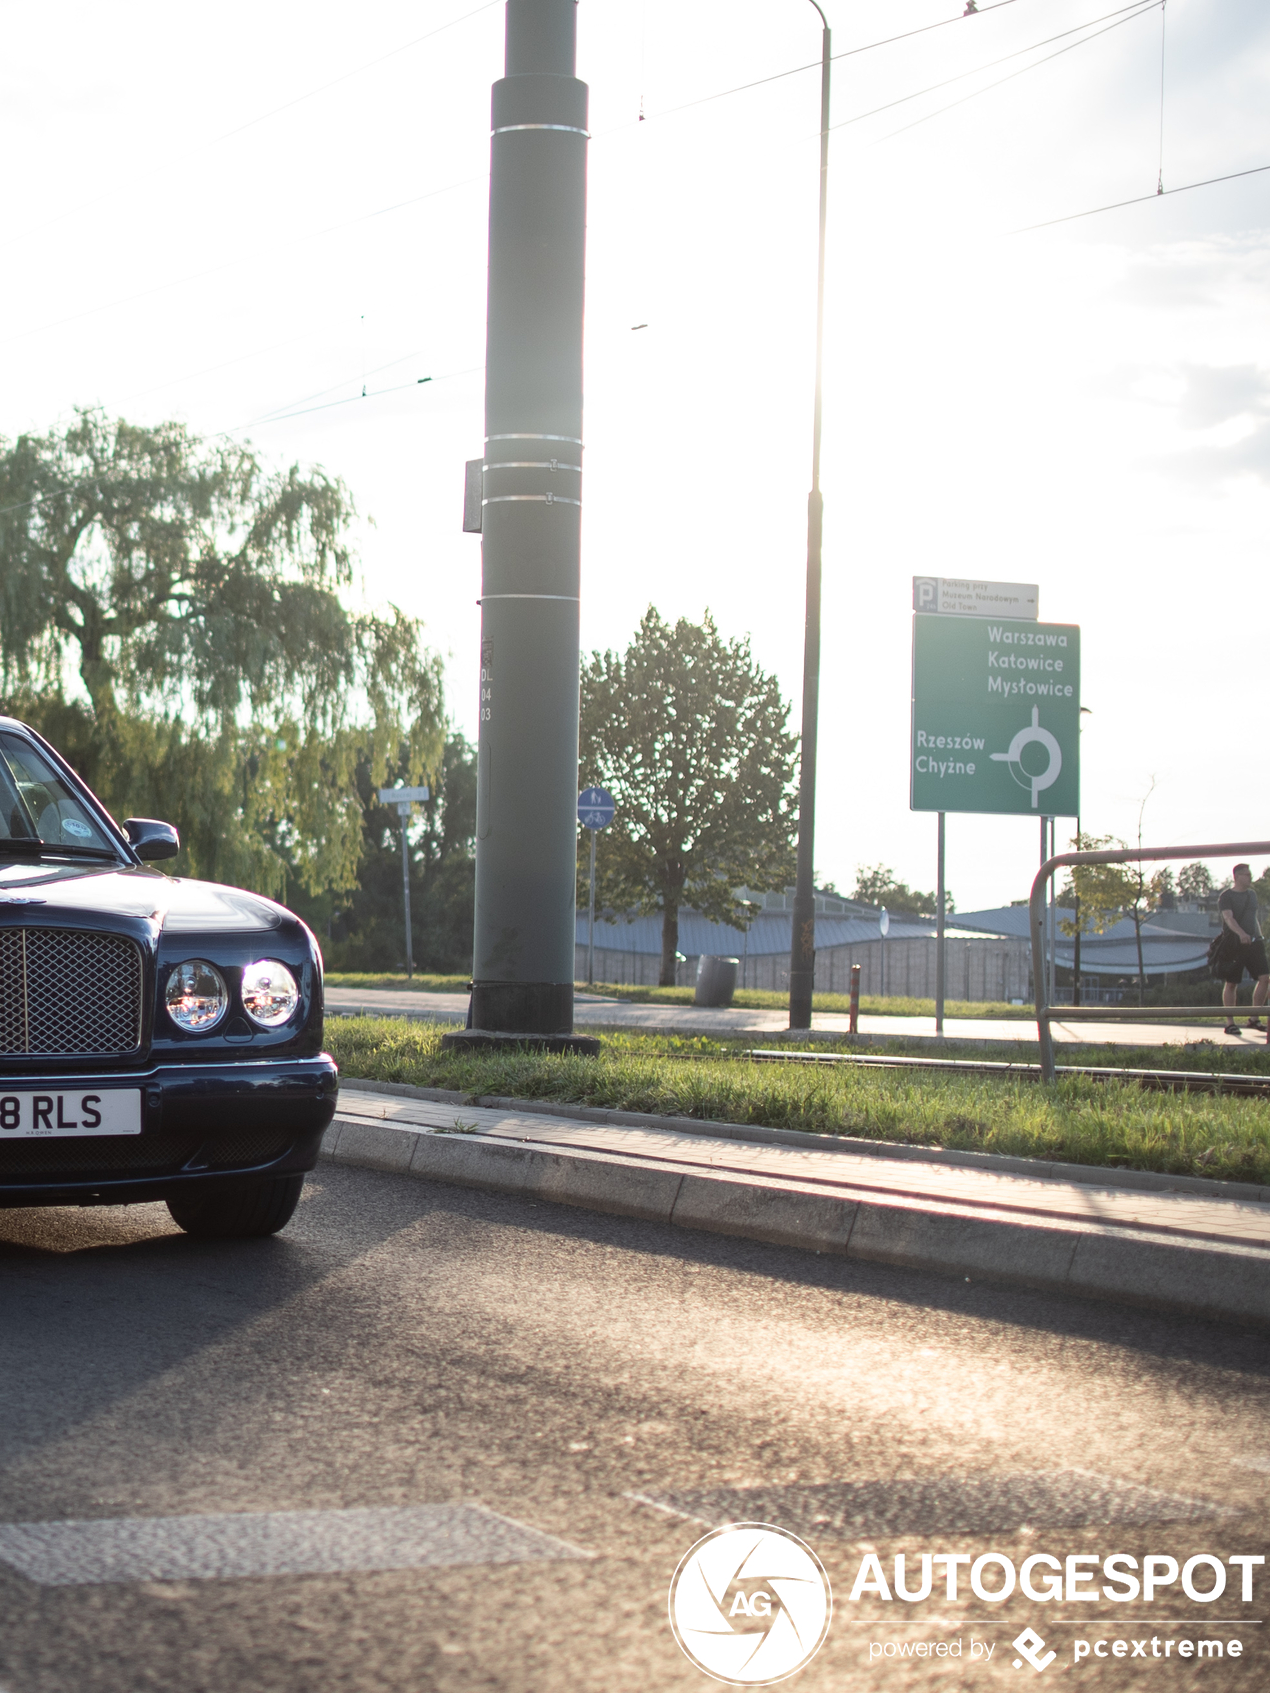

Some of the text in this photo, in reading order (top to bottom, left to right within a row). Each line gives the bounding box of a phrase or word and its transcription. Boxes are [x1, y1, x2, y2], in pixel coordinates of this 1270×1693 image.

[942, 579, 988, 592] Parking przy
[942, 590, 1020, 605] Muzeum Narodowym
[942, 600, 978, 611] Old Town
[987, 626, 1068, 647] Warszawa
[988, 651, 1064, 672] Katowice
[481, 668, 493, 681] DL
[481, 688, 491, 701] 04
[988, 675, 1073, 698] Mysłowice
[481, 707, 491, 721] 03
[917, 730, 985, 750] Rzeszów
[915, 755, 976, 778] Chyżne
[32, 1095, 102, 1129] RLS
